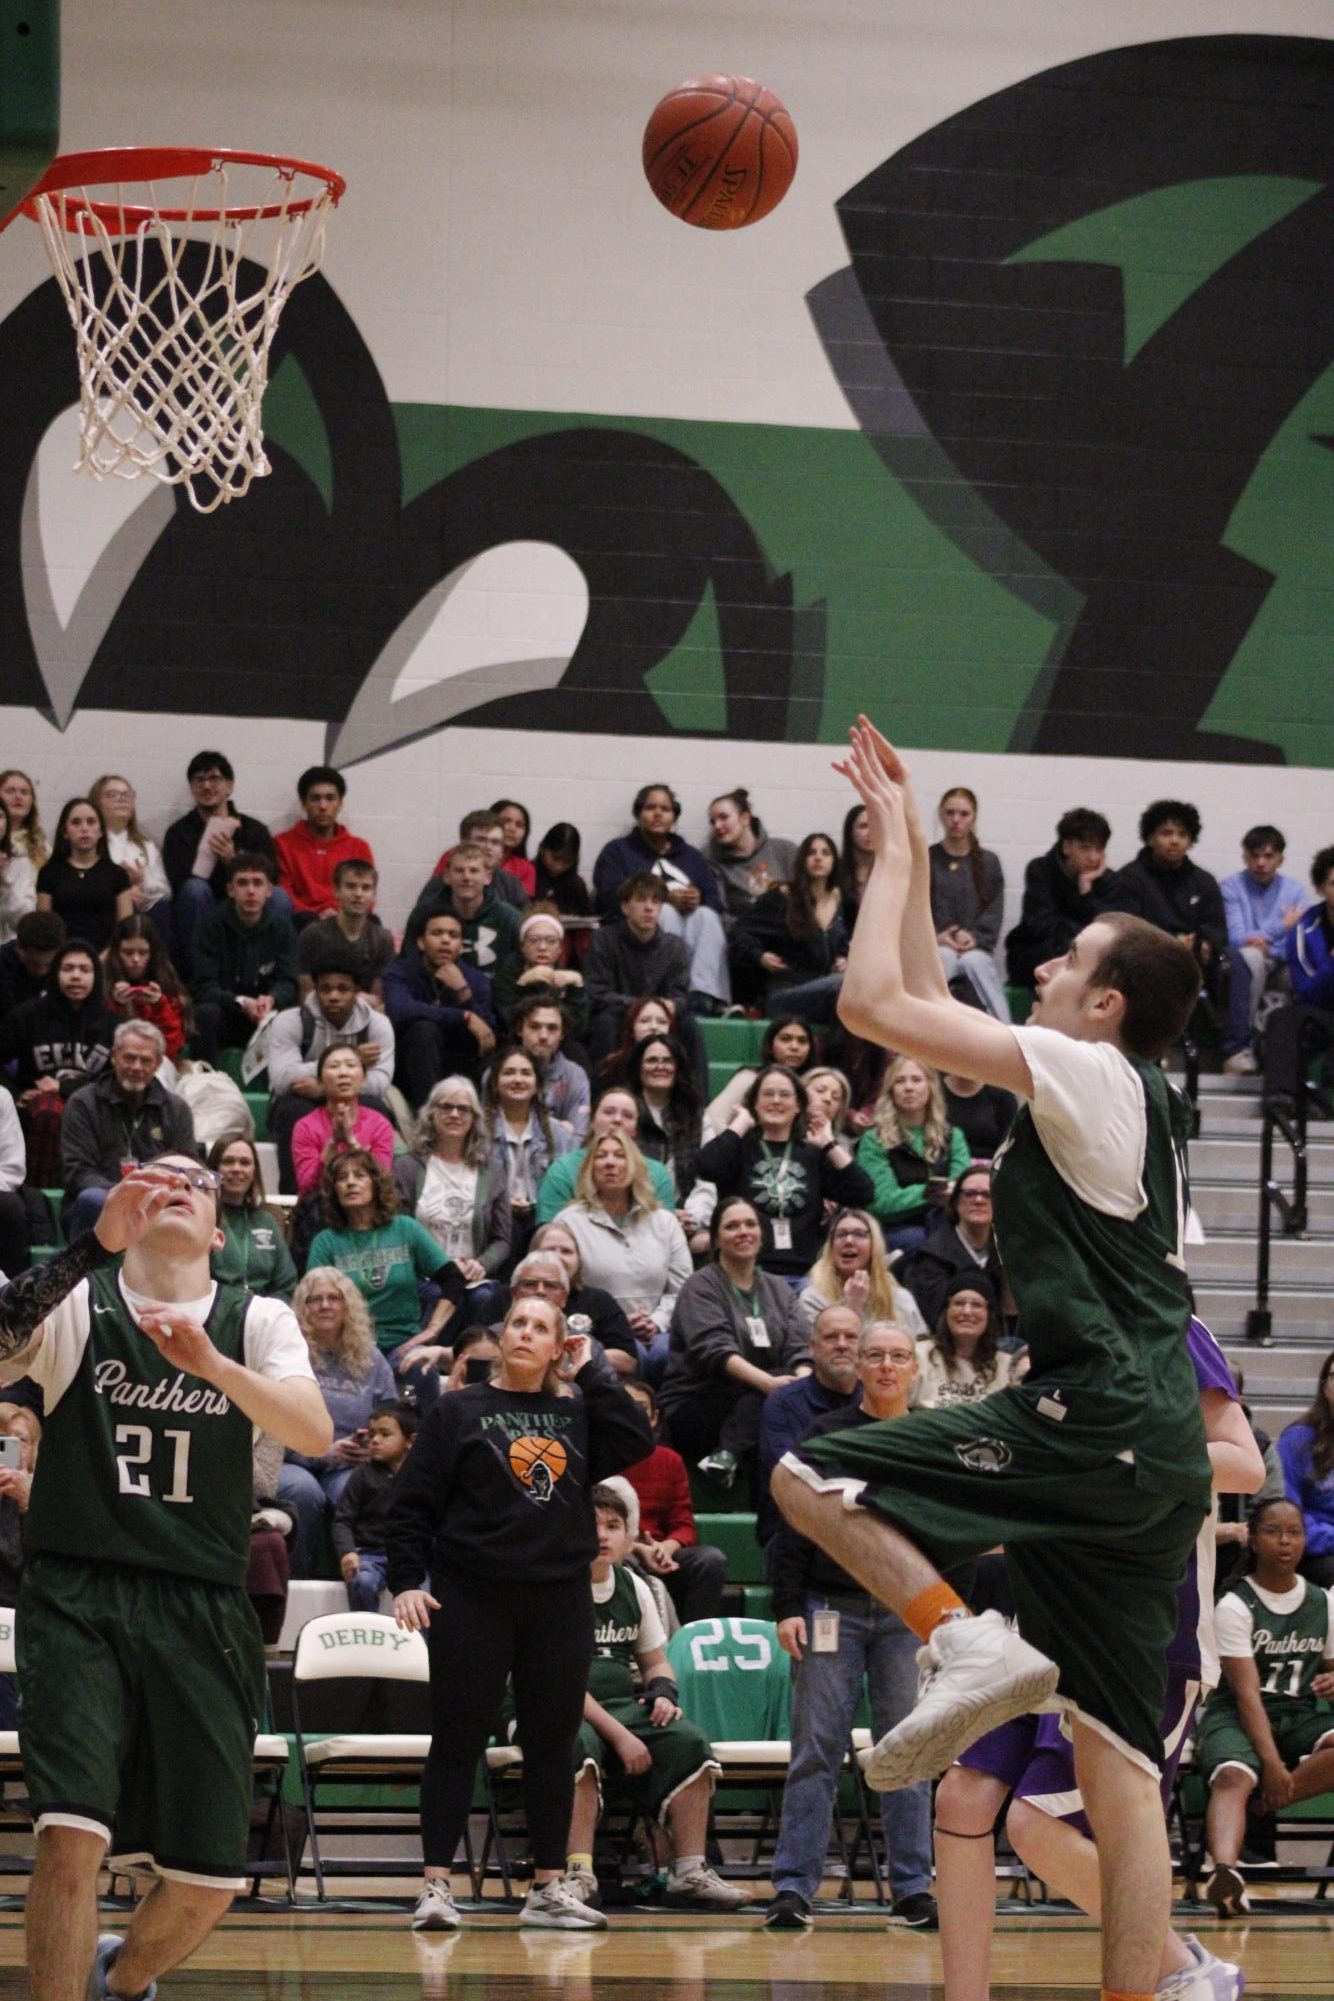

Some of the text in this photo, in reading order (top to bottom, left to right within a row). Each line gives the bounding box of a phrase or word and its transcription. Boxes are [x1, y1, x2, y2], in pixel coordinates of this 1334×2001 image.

[94, 1359, 231, 1416] Panthers
[115, 1424, 194, 1503] 21
[318, 1627, 410, 1651] DERBY
[684, 1617, 771, 1671] 25
[1253, 1629, 1325, 1655] Panthers
[1259, 1660, 1304, 1697] 11
